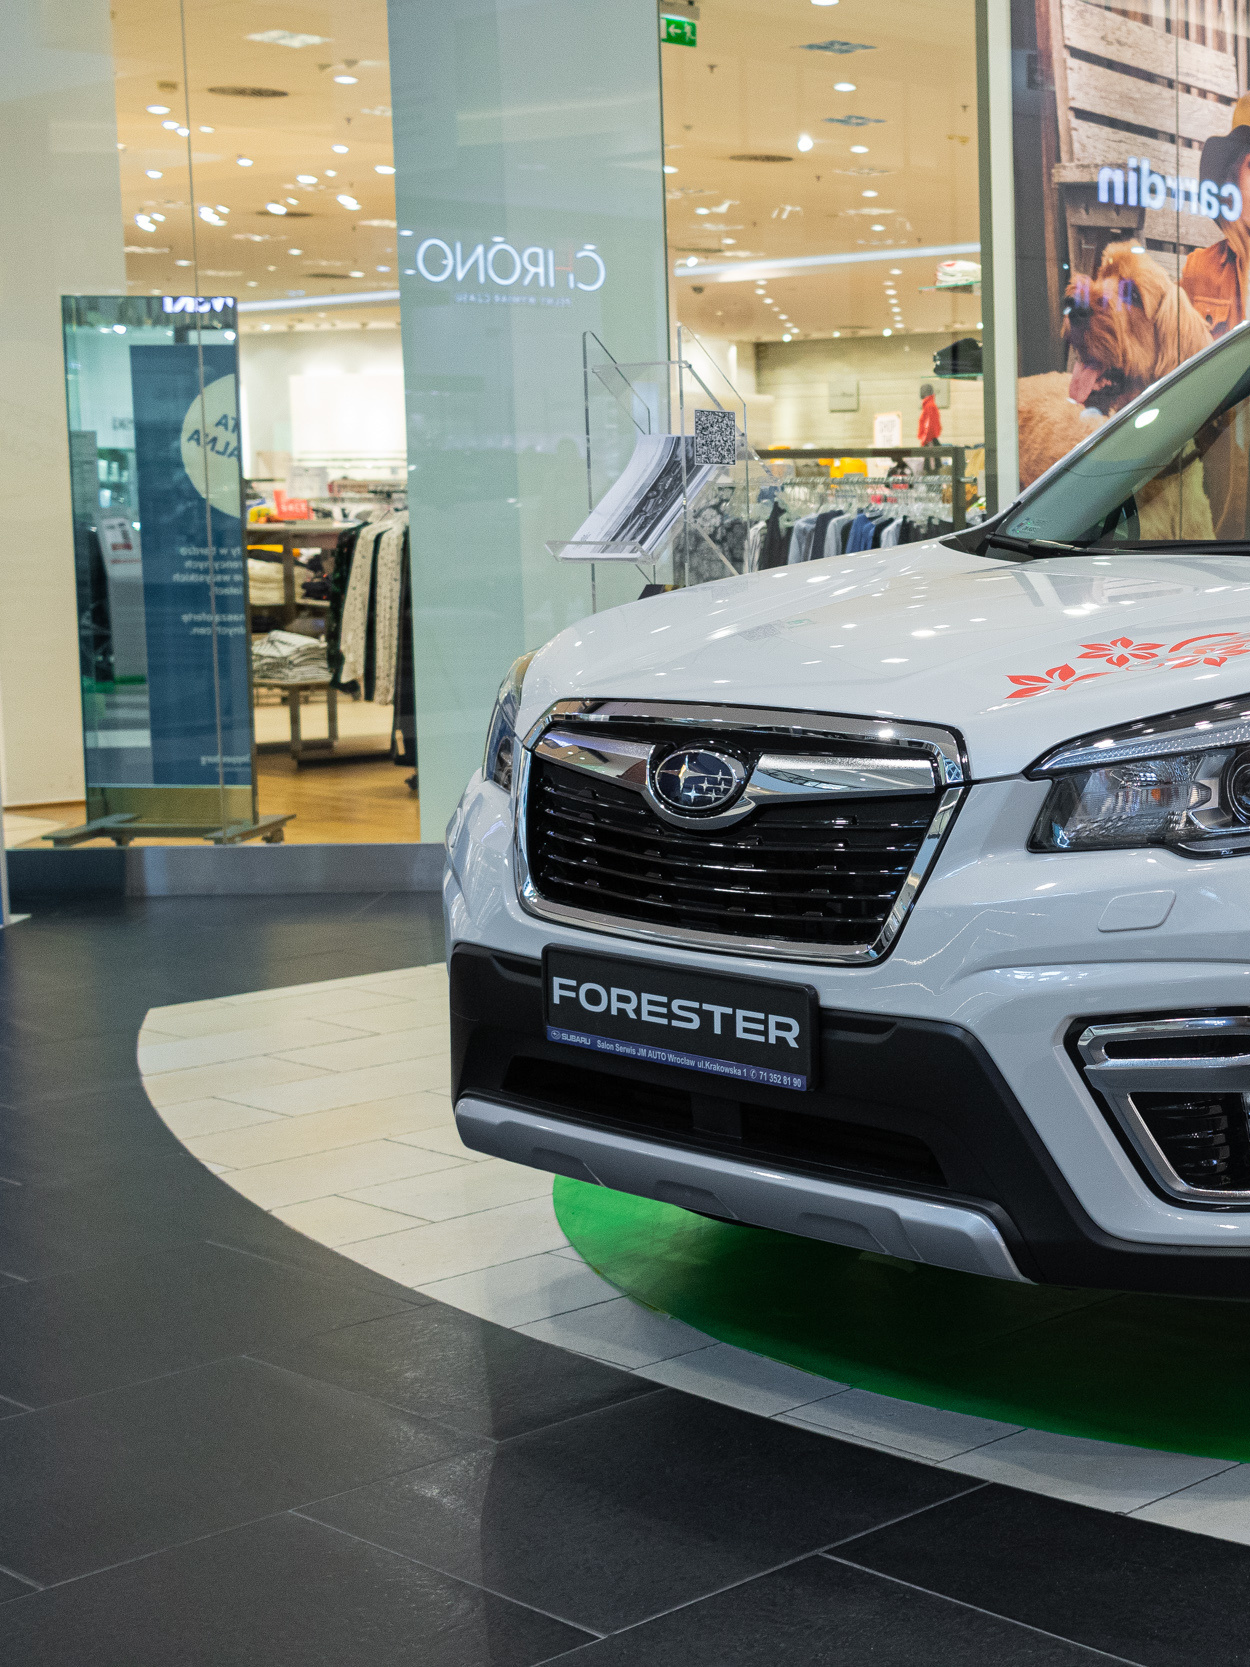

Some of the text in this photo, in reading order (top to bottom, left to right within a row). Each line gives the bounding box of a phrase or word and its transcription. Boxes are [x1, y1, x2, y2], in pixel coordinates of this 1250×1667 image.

[553, 977, 799, 1048] FORESTER
[561, 1031, 591, 1046] SUBARU
[596, 1039, 615, 1052] Salon
[615, 1042, 637, 1056] Serwis
[637, 1047, 648, 1058] JM
[647, 1049, 667, 1062] AUTO
[667, 1053, 696, 1067] Wrocław
[697, 1060, 742, 1077] ul.Krakowska
[759, 1071, 802, 1088] 71 352 81 90
